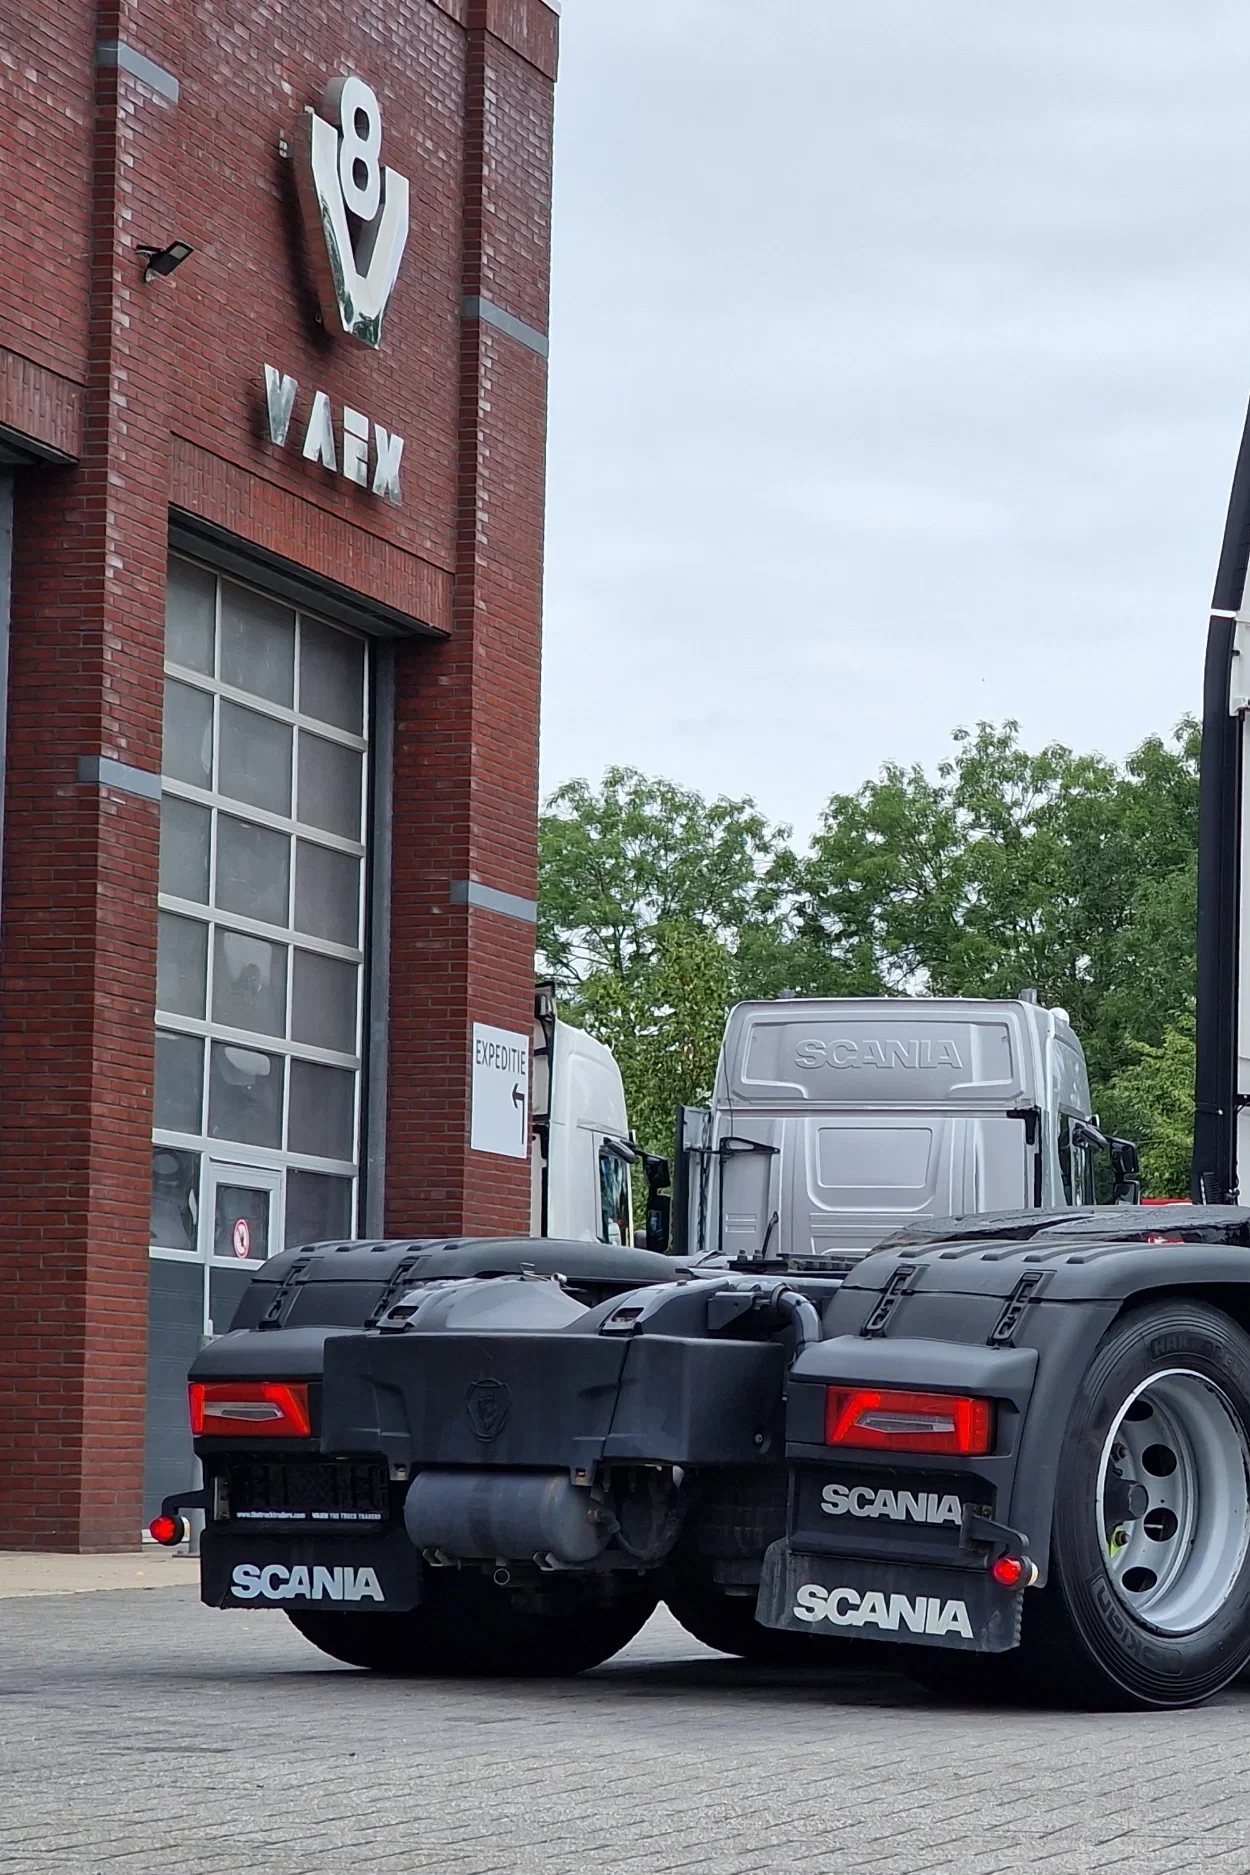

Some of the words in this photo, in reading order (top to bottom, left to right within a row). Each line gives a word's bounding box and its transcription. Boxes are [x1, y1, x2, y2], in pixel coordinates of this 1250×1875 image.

[475, 1038, 526, 1076] EXPEDITIE
[794, 1038, 963, 1069] SCANIA
[821, 1484, 962, 1525] SCANIA
[231, 1564, 385, 1602] SCANIA
[793, 1584, 972, 1639] SCANIA
